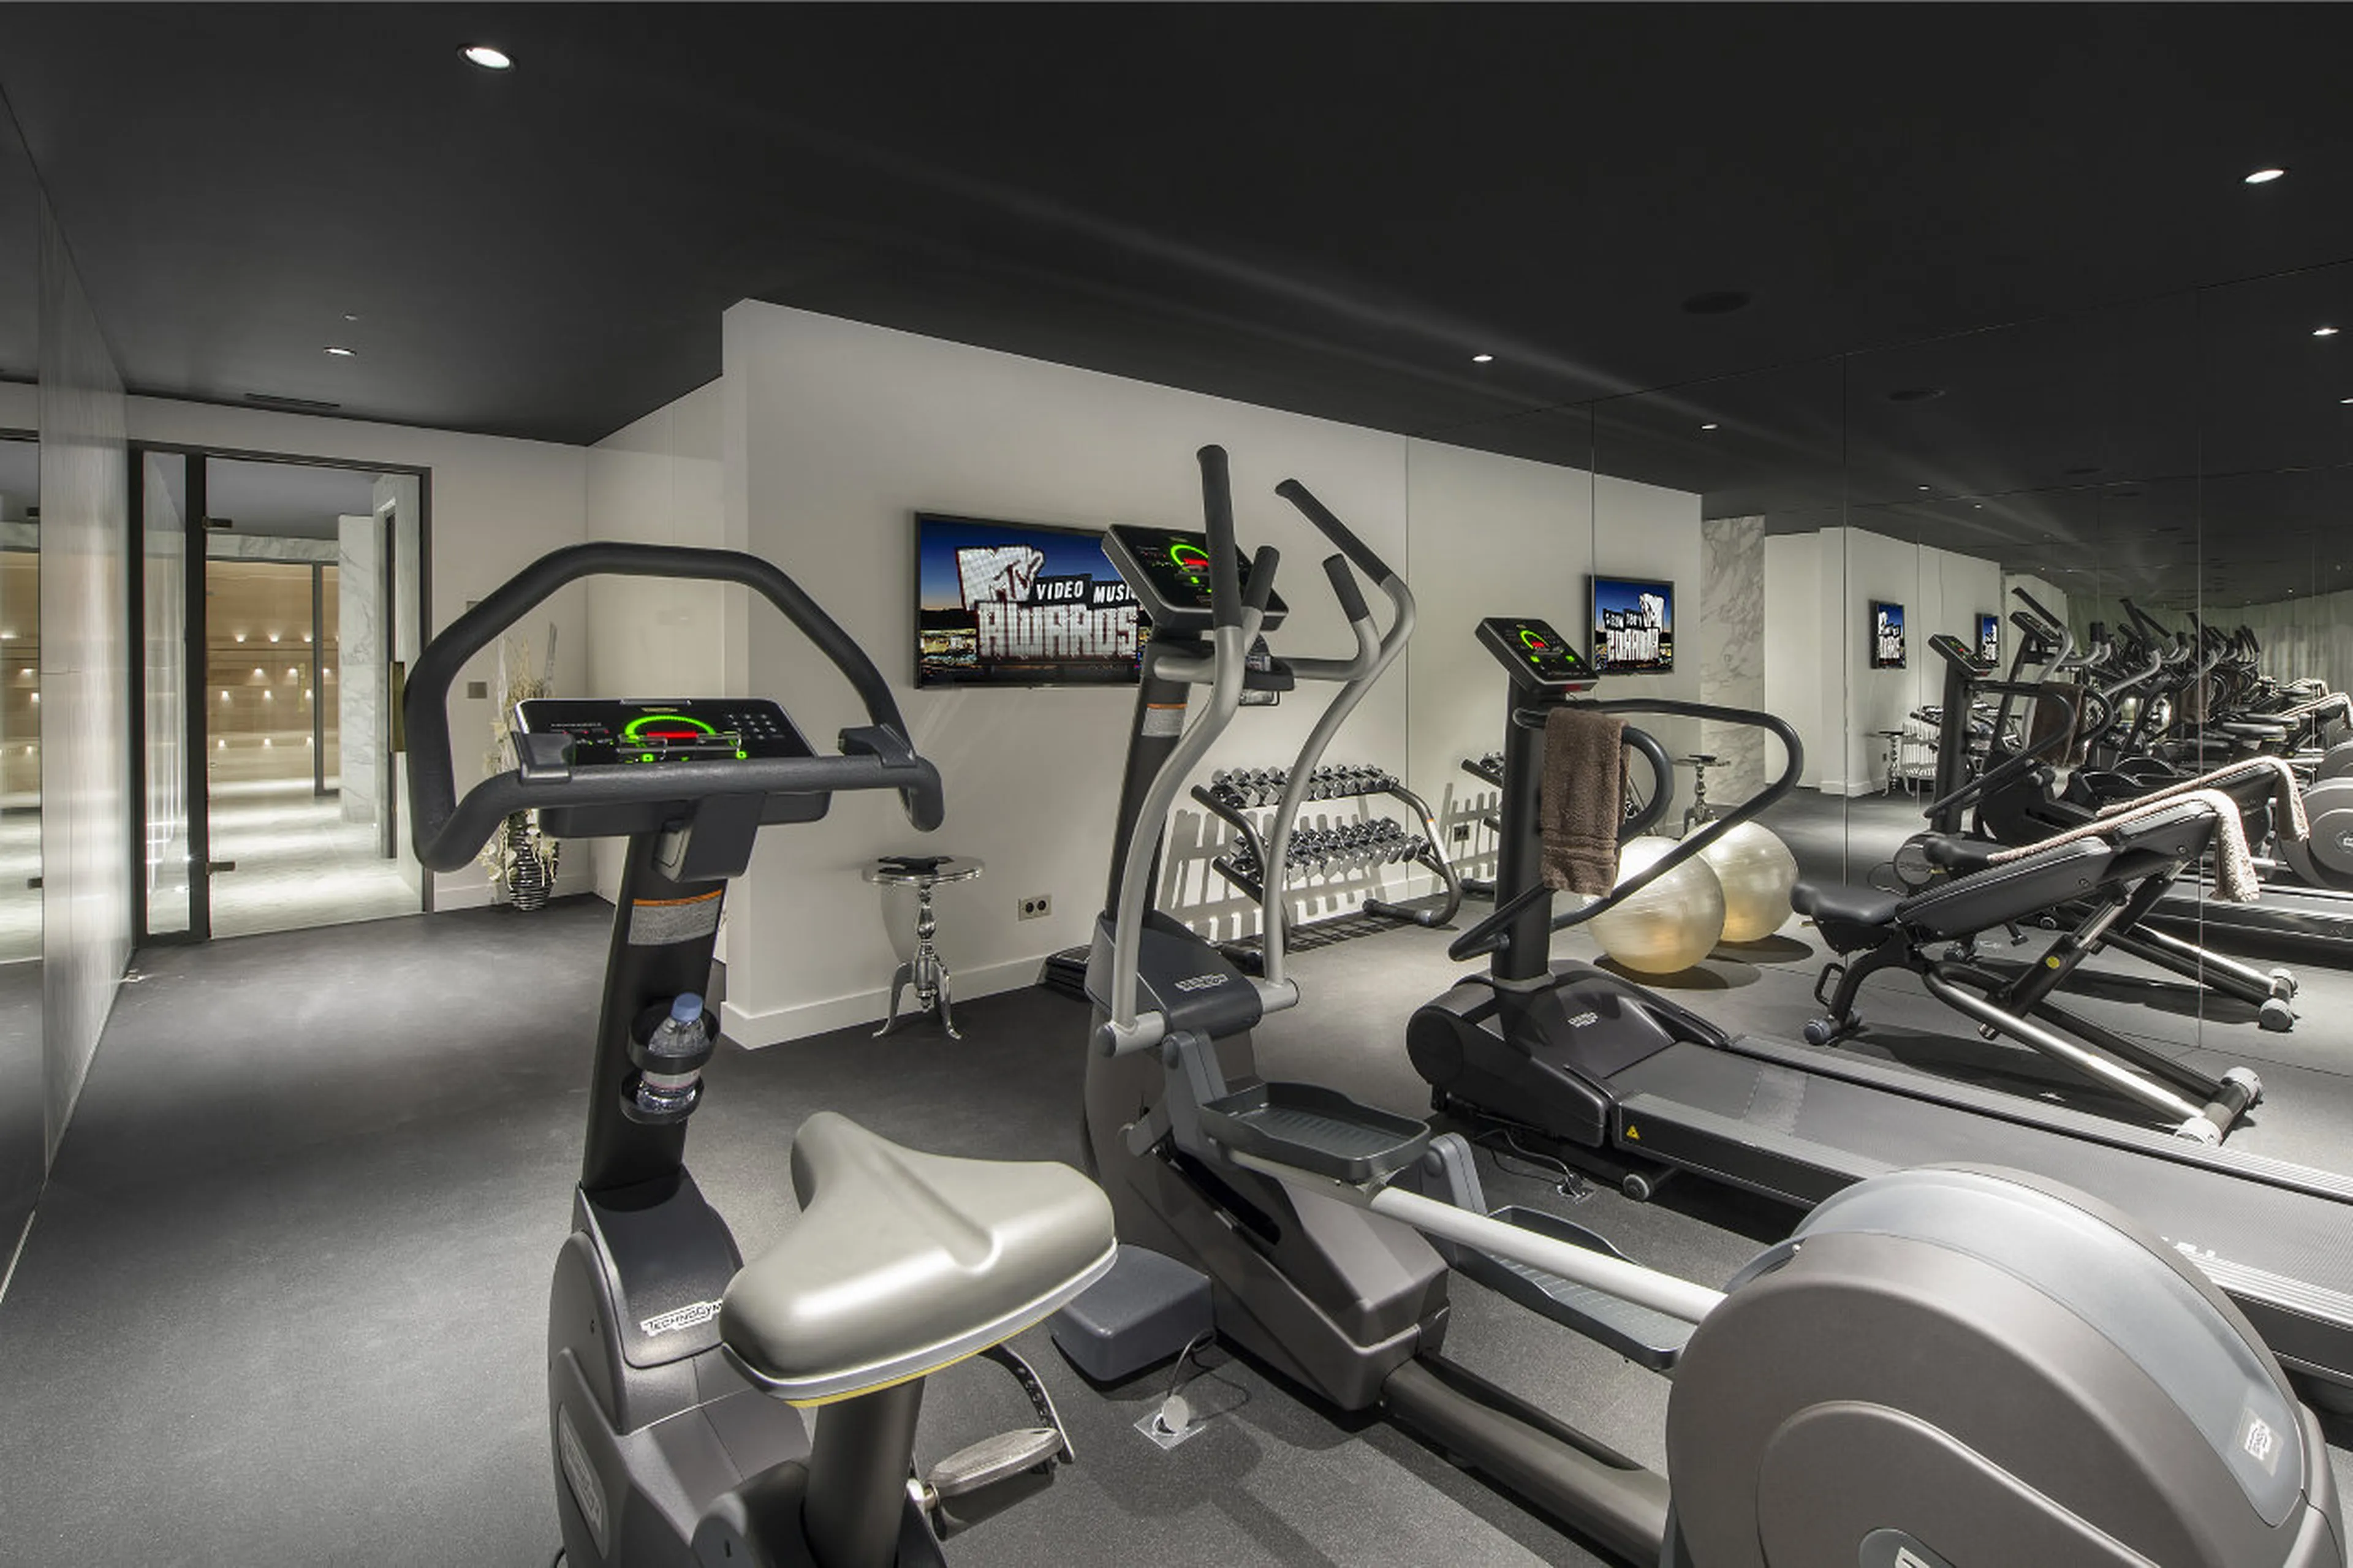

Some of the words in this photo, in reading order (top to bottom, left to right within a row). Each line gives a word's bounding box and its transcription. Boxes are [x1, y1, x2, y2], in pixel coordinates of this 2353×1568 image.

[957, 545, 1044, 611] MTV
[1036, 580, 1084, 600] VIDEO
[977, 602, 1138, 658] AWARDS
